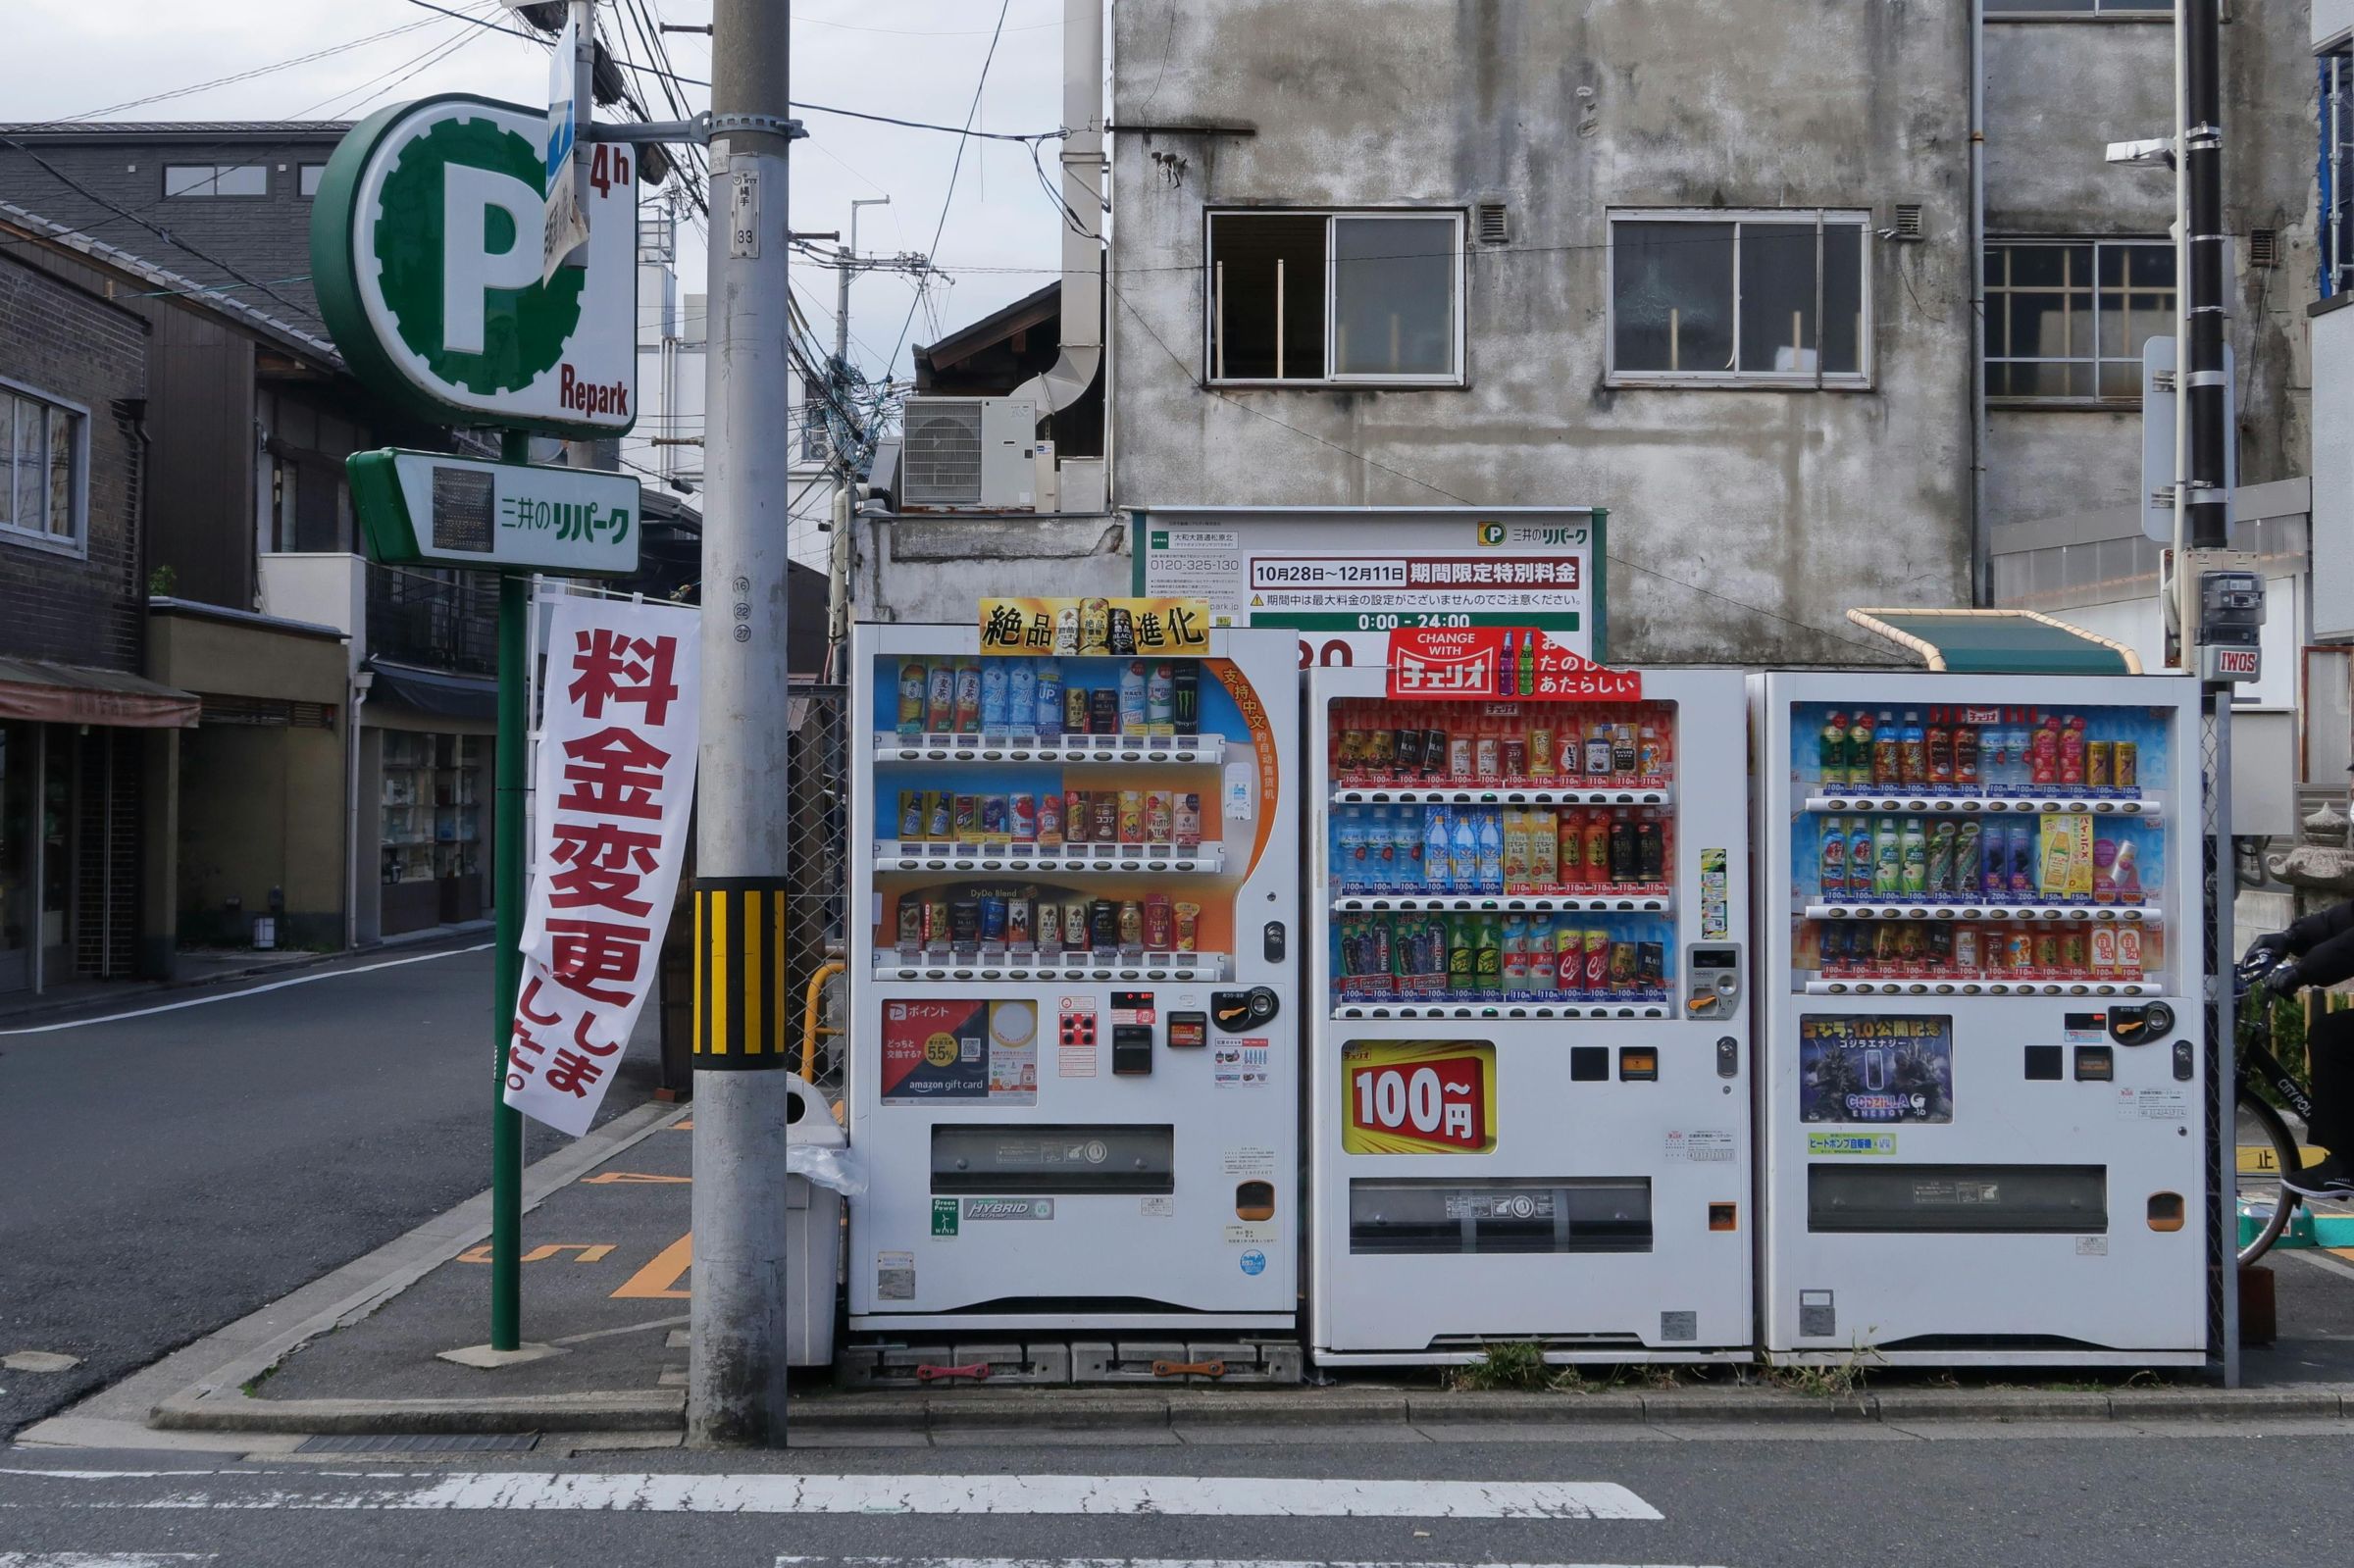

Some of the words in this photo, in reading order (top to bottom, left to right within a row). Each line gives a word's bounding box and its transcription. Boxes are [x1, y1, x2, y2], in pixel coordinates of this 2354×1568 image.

[738, 229, 753, 243] 33
[443, 161, 547, 355] P
[560, 363, 628, 419] Repark
[501, 496, 629, 545] 三井のリパーク
[1490, 527, 1502, 541] P
[1512, 527, 1587, 544] 三井のリパーク
[1151, 561, 1239, 571] 0120-325-130
[1410, 563, 1576, 582] 期間限定特別料金
[1267, 594, 1581, 606] 期間中は最大料金の設定がございませんのでご注意ください。
[982, 604, 1052, 647] 絶品
[1135, 607, 1203, 646] 進化
[1358, 614, 1398, 630] 0:00
[1417, 614, 1469, 629] 24:00
[1417, 633, 1475, 643] CHANGE
[1429, 645, 1461, 655] WITH
[1403, 657, 1486, 688] チェリオ
[1540, 677, 1634, 692] あたらしい
[1487, 704, 1516, 714] チェリオ
[1970, 712, 1997, 721] チェリオ
[971, 888, 993, 898] DyDo
[1380, 932, 1389, 971] JUNGLEMAN
[908, 1006, 949, 1018] ポイント
[1840, 1039, 1907, 1048] ゴジラエナジー
[928, 1045, 953, 1061] 5.5%
[946, 1080, 961, 1091] gift
[963, 1080, 983, 1088] card
[1846, 1094, 1909, 1110] GODZILLA
[2257, 1150, 2274, 1169] 止
[968, 1204, 1028, 1217] HYBRID
